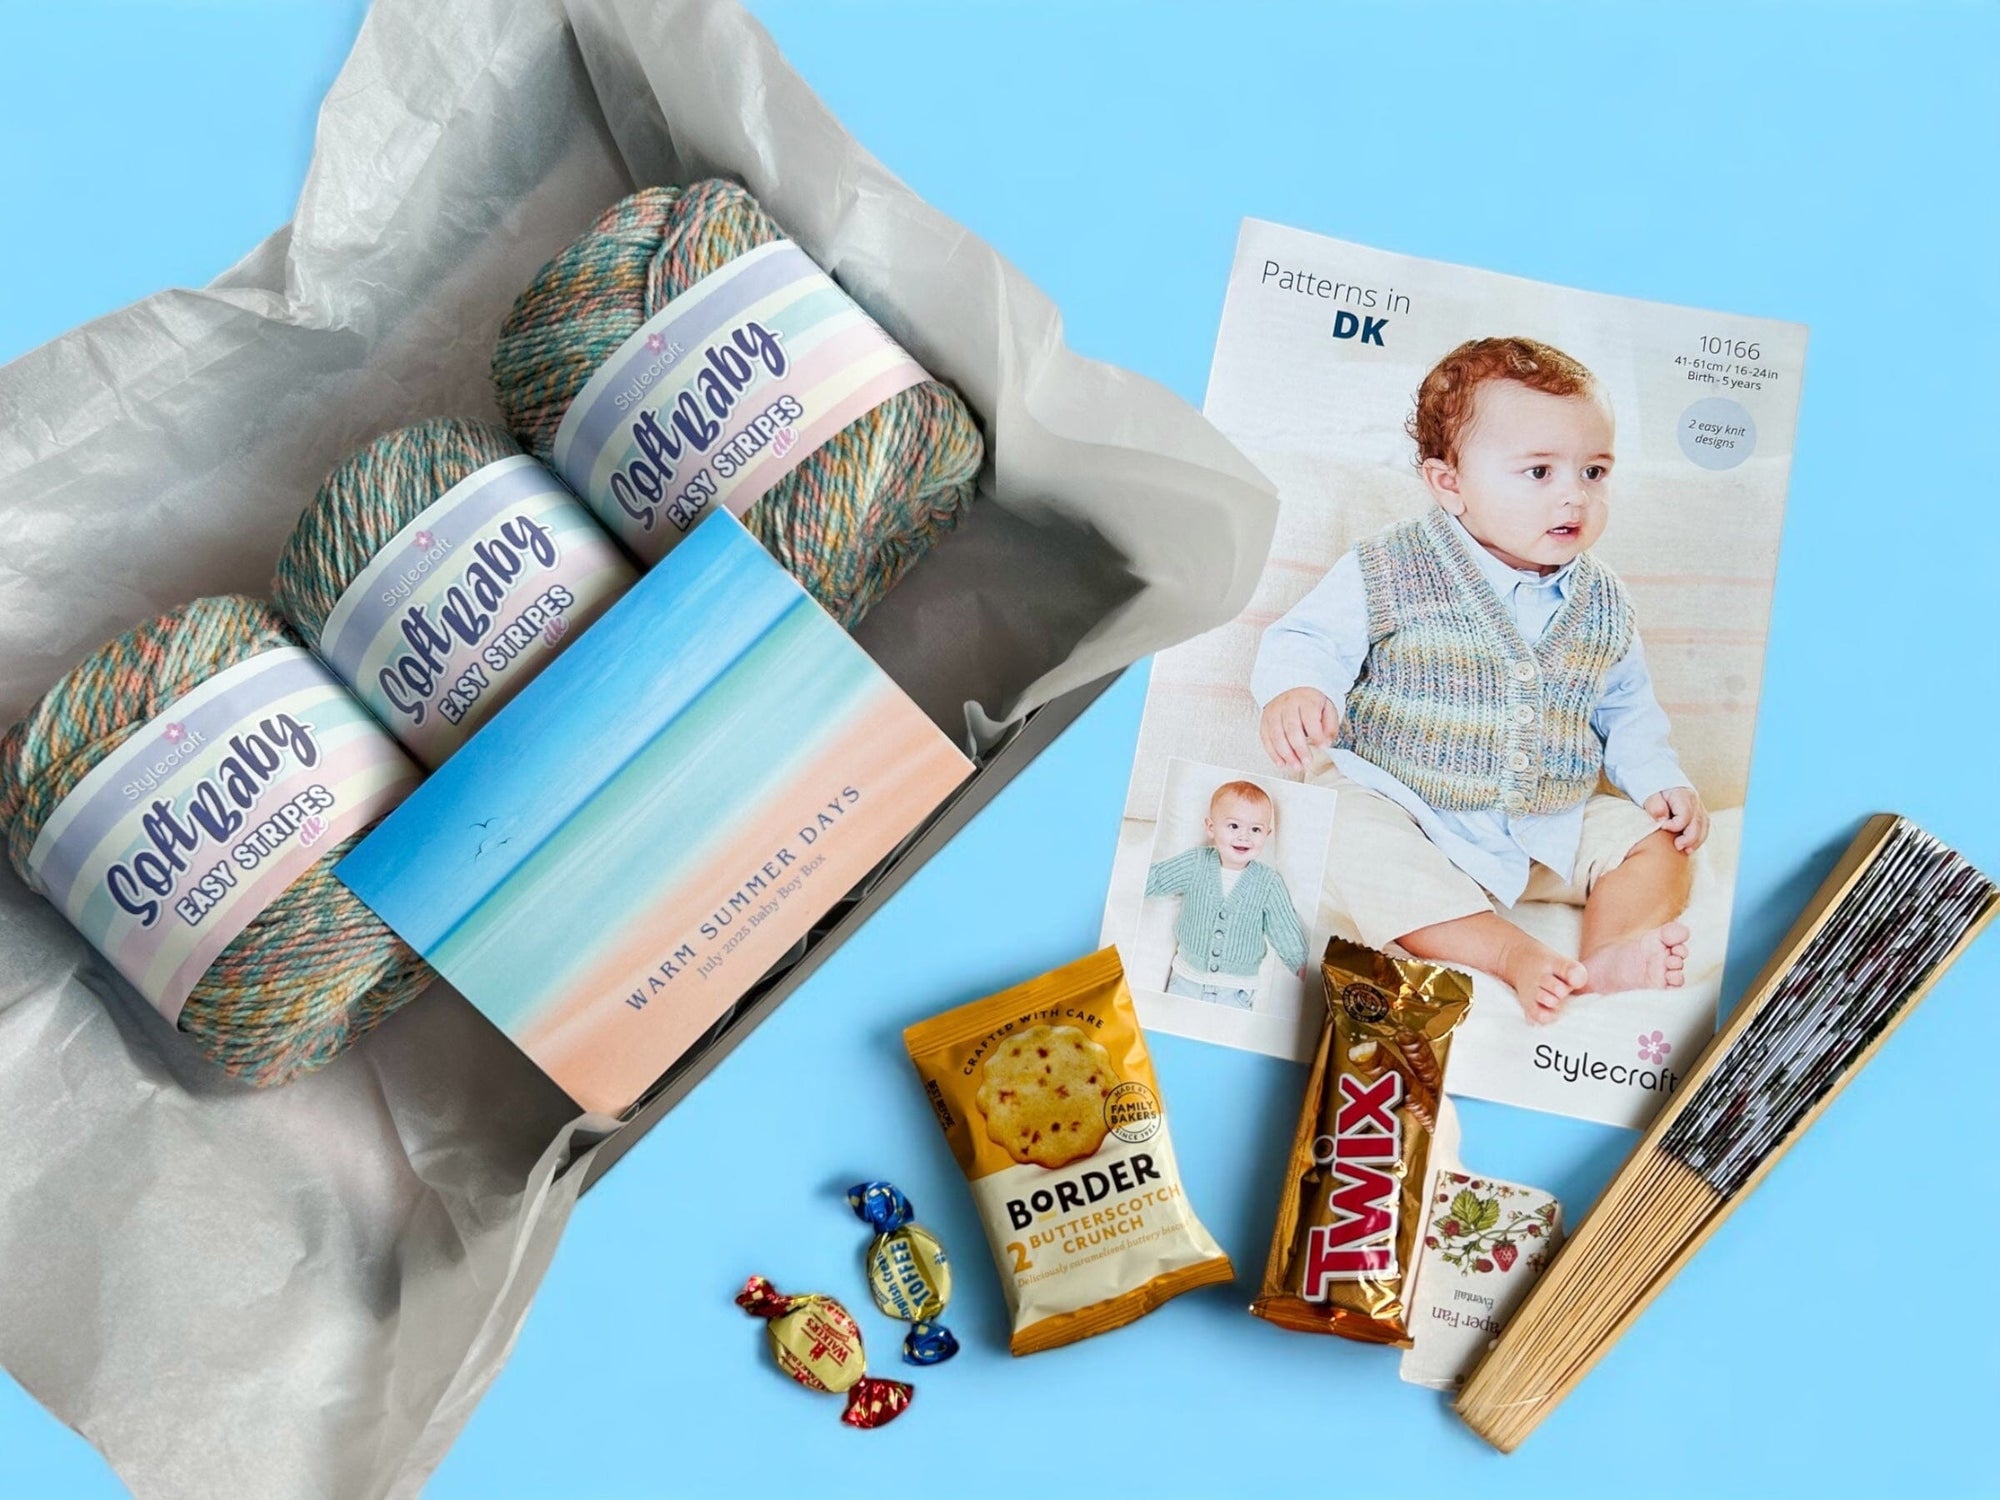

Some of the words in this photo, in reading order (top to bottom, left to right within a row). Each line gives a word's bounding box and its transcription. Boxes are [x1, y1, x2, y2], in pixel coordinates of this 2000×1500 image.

[1262, 260, 1377, 308] Patterns
[1387, 288, 1410, 314] in
[1332, 310, 1389, 347] DK
[1700, 335, 1761, 360] 10166
[614, 341, 685, 411] Stylecraft
[1674, 356, 1723, 372] 41-61cm
[1735, 365, 1778, 380] 16-24in
[1688, 419, 1697, 429] 2
[1699, 422, 1723, 435] easy
[1724, 424, 1746, 437] knit
[1695, 434, 1735, 449] designs
[667, 468, 717, 532] EASY
[712, 395, 803, 478] STRIPES
[381, 537, 453, 607] Stylecraft
[438, 663, 489, 726] EASY
[482, 584, 574, 671] STRIPES
[123, 730, 207, 800] Stylecraft
[175, 860, 237, 926] EASY
[232, 784, 334, 869] STRIPES
[625, 943, 697, 1012] WARM
[700, 847, 796, 940] SUMMER
[799, 785, 860, 845] DAYS
[697, 950, 724, 979] July
[722, 926, 751, 954] 2025
[748, 898, 779, 927] Baby
[777, 875, 803, 899] Boy
[801, 854, 827, 877] Box
[963, 1022, 1014, 1075] CRAFTED
[1019, 1009, 1059, 1024] WITH
[1066, 1008, 1104, 1029] CARE
[1114, 1085, 1135, 1097] MADE
[1533, 1044, 1679, 1094] Stylecraft
[1111, 1101, 1153, 1114] FAMILY
[1111, 1111, 1157, 1124] BAKERS
[1115, 1127, 1138, 1140] SINCE
[1029, 1184, 1181, 1249] BUTTERSCOTCH
[1063, 1215, 1144, 1254] CRUNCH
[890, 1241, 931, 1307] TOFFEE
[1006, 1241, 1033, 1274] 2
[1017, 1263, 1069, 1288] Deliciously
[1127, 1230, 1161, 1251] buttery
[805, 1317, 848, 1363] WALKER'S
[1432, 1306, 1460, 1327] Fan
[1462, 1315, 1502, 1337] aper
